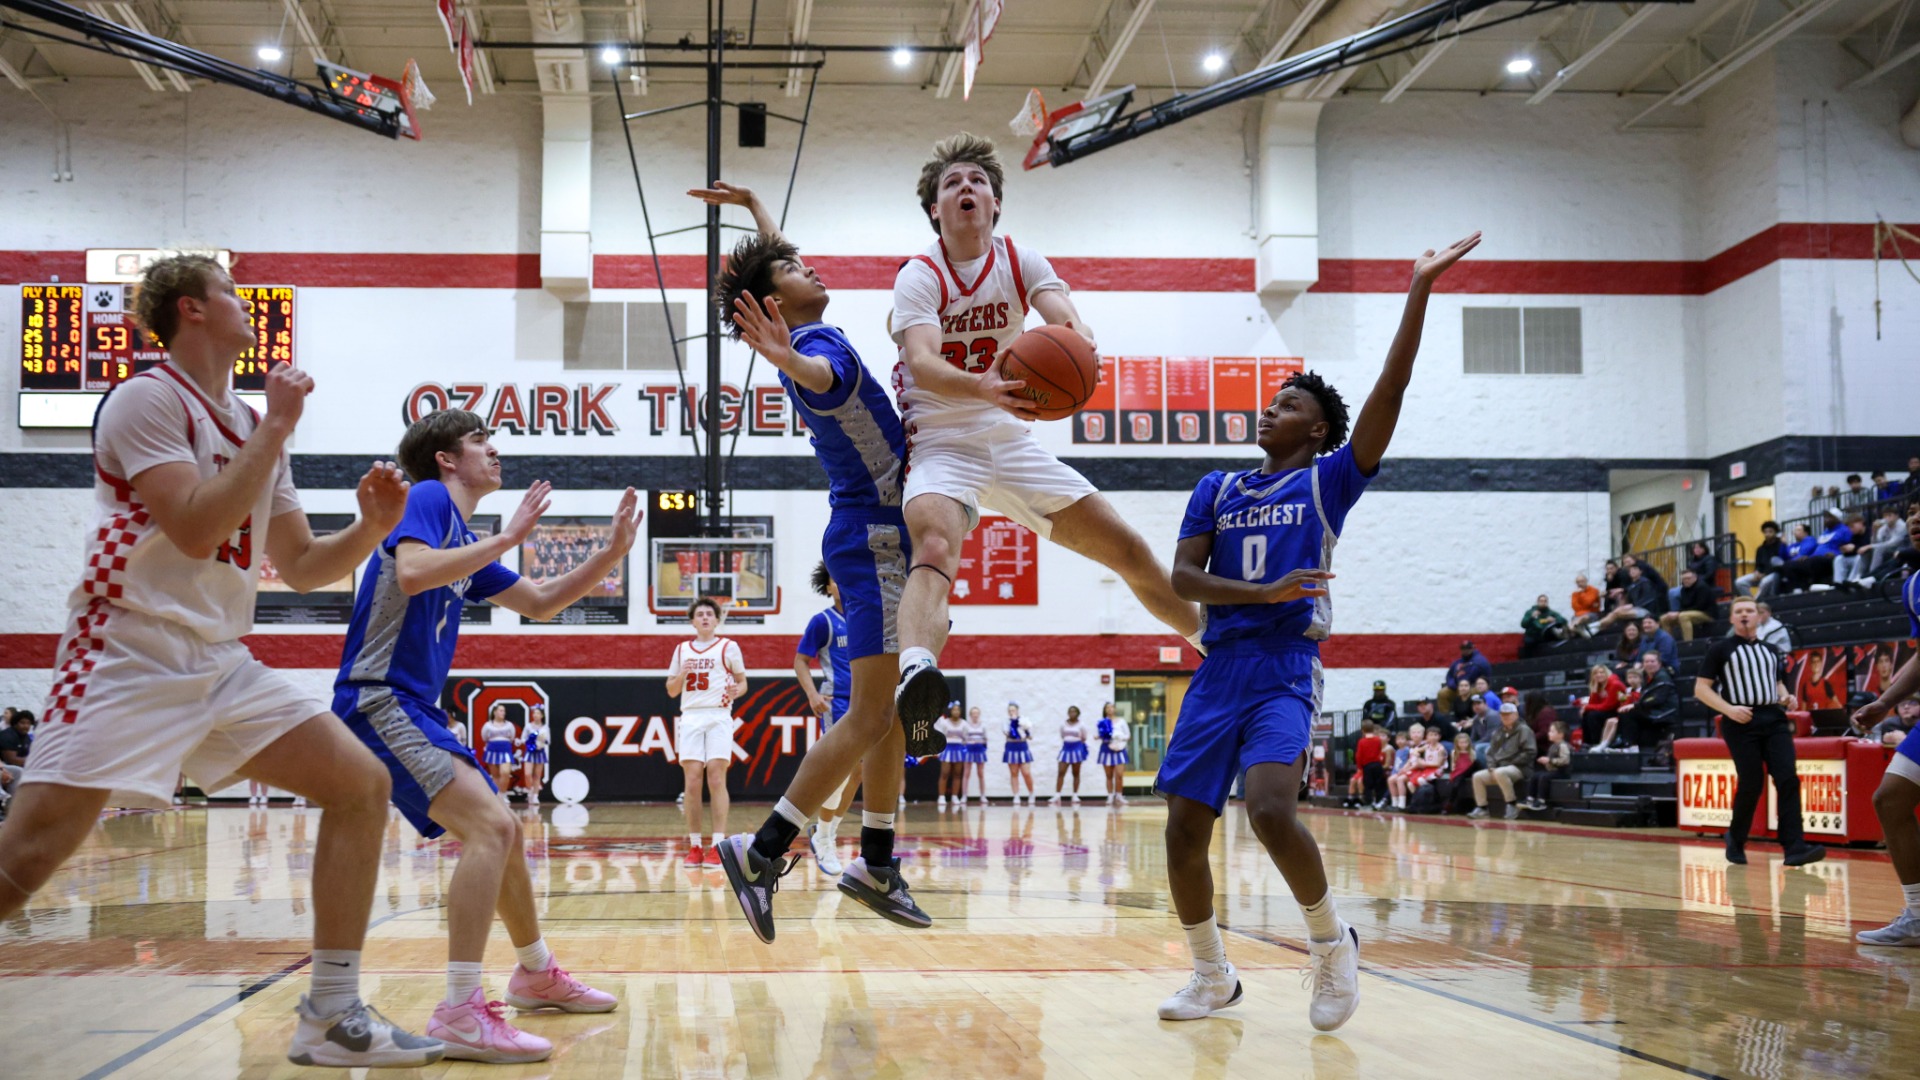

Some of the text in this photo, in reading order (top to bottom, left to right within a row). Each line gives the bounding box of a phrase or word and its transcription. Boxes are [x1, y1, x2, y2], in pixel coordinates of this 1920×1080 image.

[23, 286, 83, 299] PLY FL PTS
[257, 287, 270, 300] FL
[272, 287, 293, 300] PTS
[34, 299, 80, 313] 3 3 2
[258, 301, 269, 314] 4
[280, 300, 291, 315] 0
[48, 314, 58, 328] 3
[70, 314, 80, 328] 5
[93, 314, 124, 324] HOME
[258, 315, 269, 330] 2
[285, 316, 291, 329] 1
[23, 329, 80, 343] 25 1 0
[97, 327, 128, 350] 53
[258, 330, 291, 345] 3 16
[24, 344, 80, 358] 33 1 21
[133, 352, 161, 360] PLAYER
[257, 345, 268, 360] 2
[271, 345, 291, 360] 26
[940, 336, 998, 374] 33
[23, 359, 80, 373] 43 0 19
[102, 361, 108, 377] 1
[117, 363, 128, 378] 3
[234, 359, 255, 375] 21
[257, 361, 268, 374] 4
[402, 382, 621, 436] OZARK
[638, 383, 808, 437] TIGE
[659, 493, 695, 510] 6:51
[1242, 534, 1267, 581] 0
[685, 658, 715, 670] GERS
[686, 672, 709, 691] 25
[565, 716, 818, 762] OZA TI
[1696, 763, 1721, 771] WELCOME
